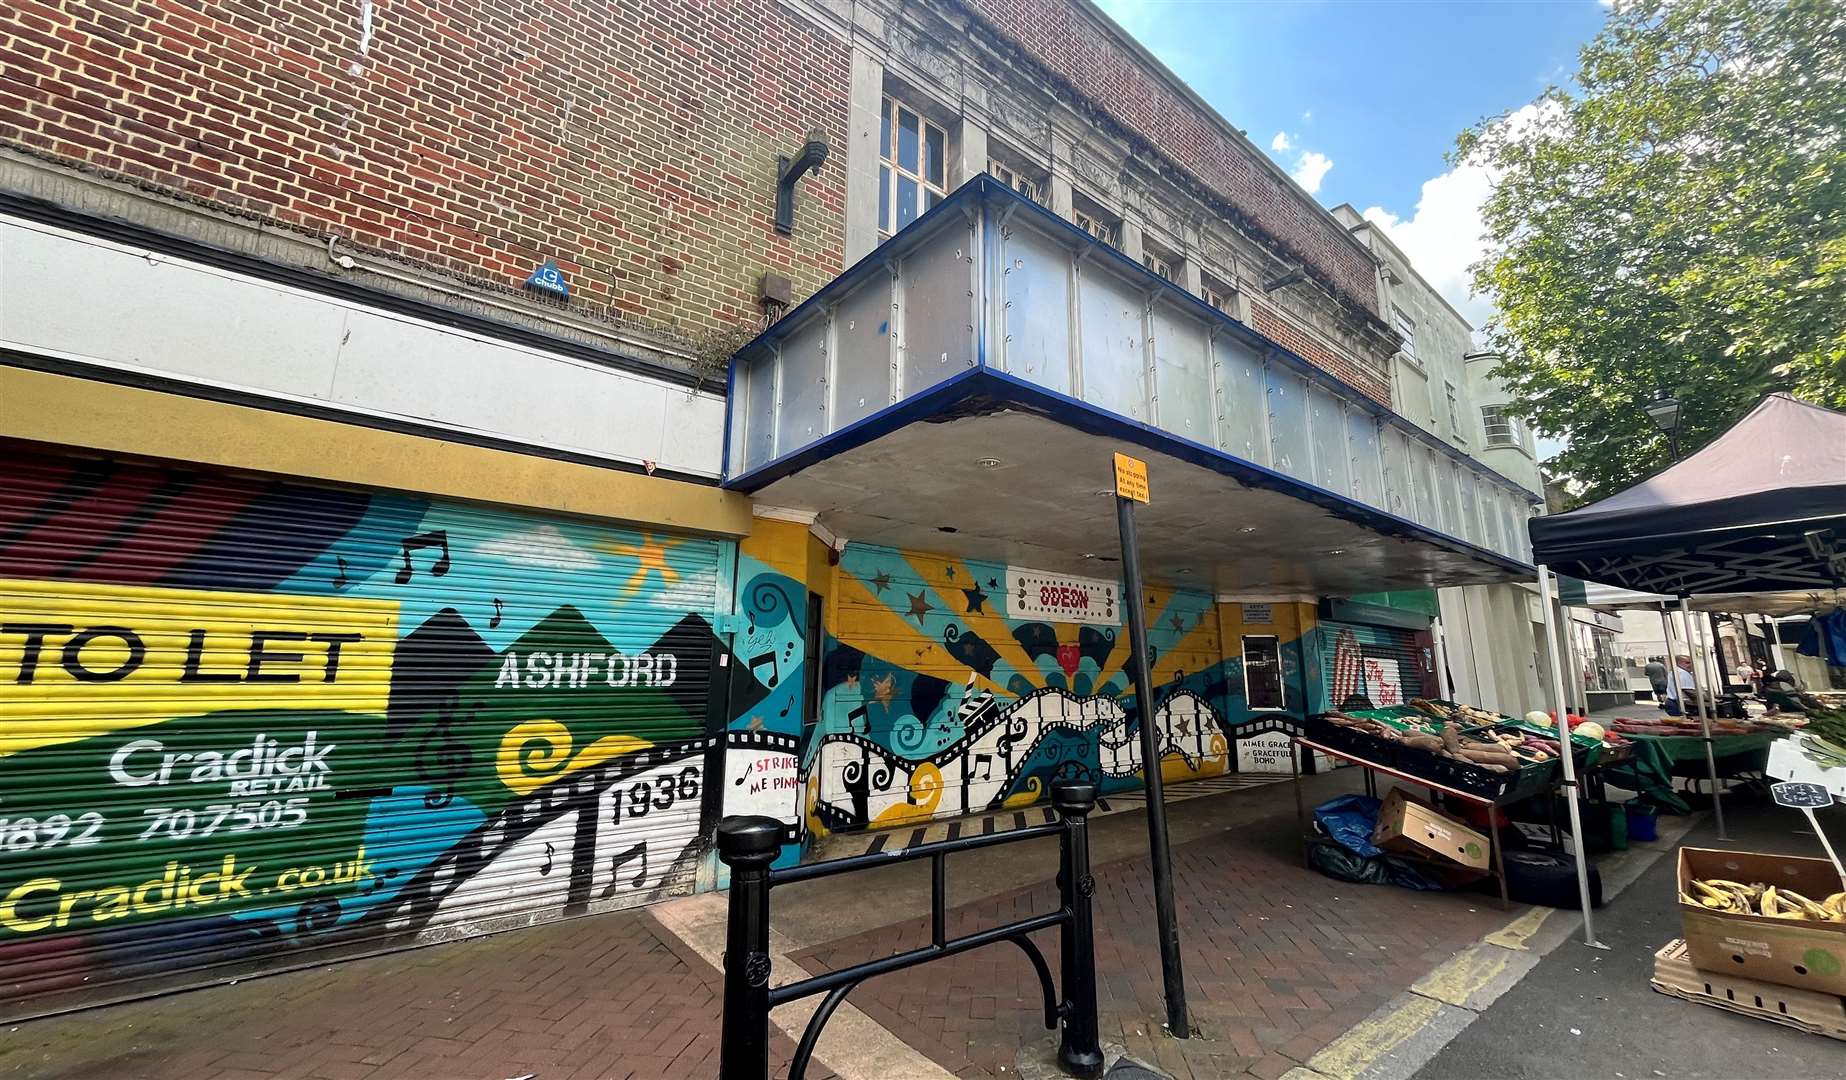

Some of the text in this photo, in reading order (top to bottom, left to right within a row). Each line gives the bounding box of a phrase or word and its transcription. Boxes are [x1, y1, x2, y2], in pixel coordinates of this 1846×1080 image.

[534, 277, 564, 291] Chubb
[1040, 586, 1089, 609] ODEON
[1, 623, 365, 685] TO LET
[494, 652, 678, 689] ASHFORD
[1242, 740, 1266, 748] AIMEE
[108, 731, 336, 786] Cradick
[756, 757, 798, 772] STRIKE
[1254, 757, 1276, 765] BOHO
[228, 774, 332, 797] RETAIL
[613, 766, 701, 826] 1936
[750, 777, 800, 795] ME PINK
